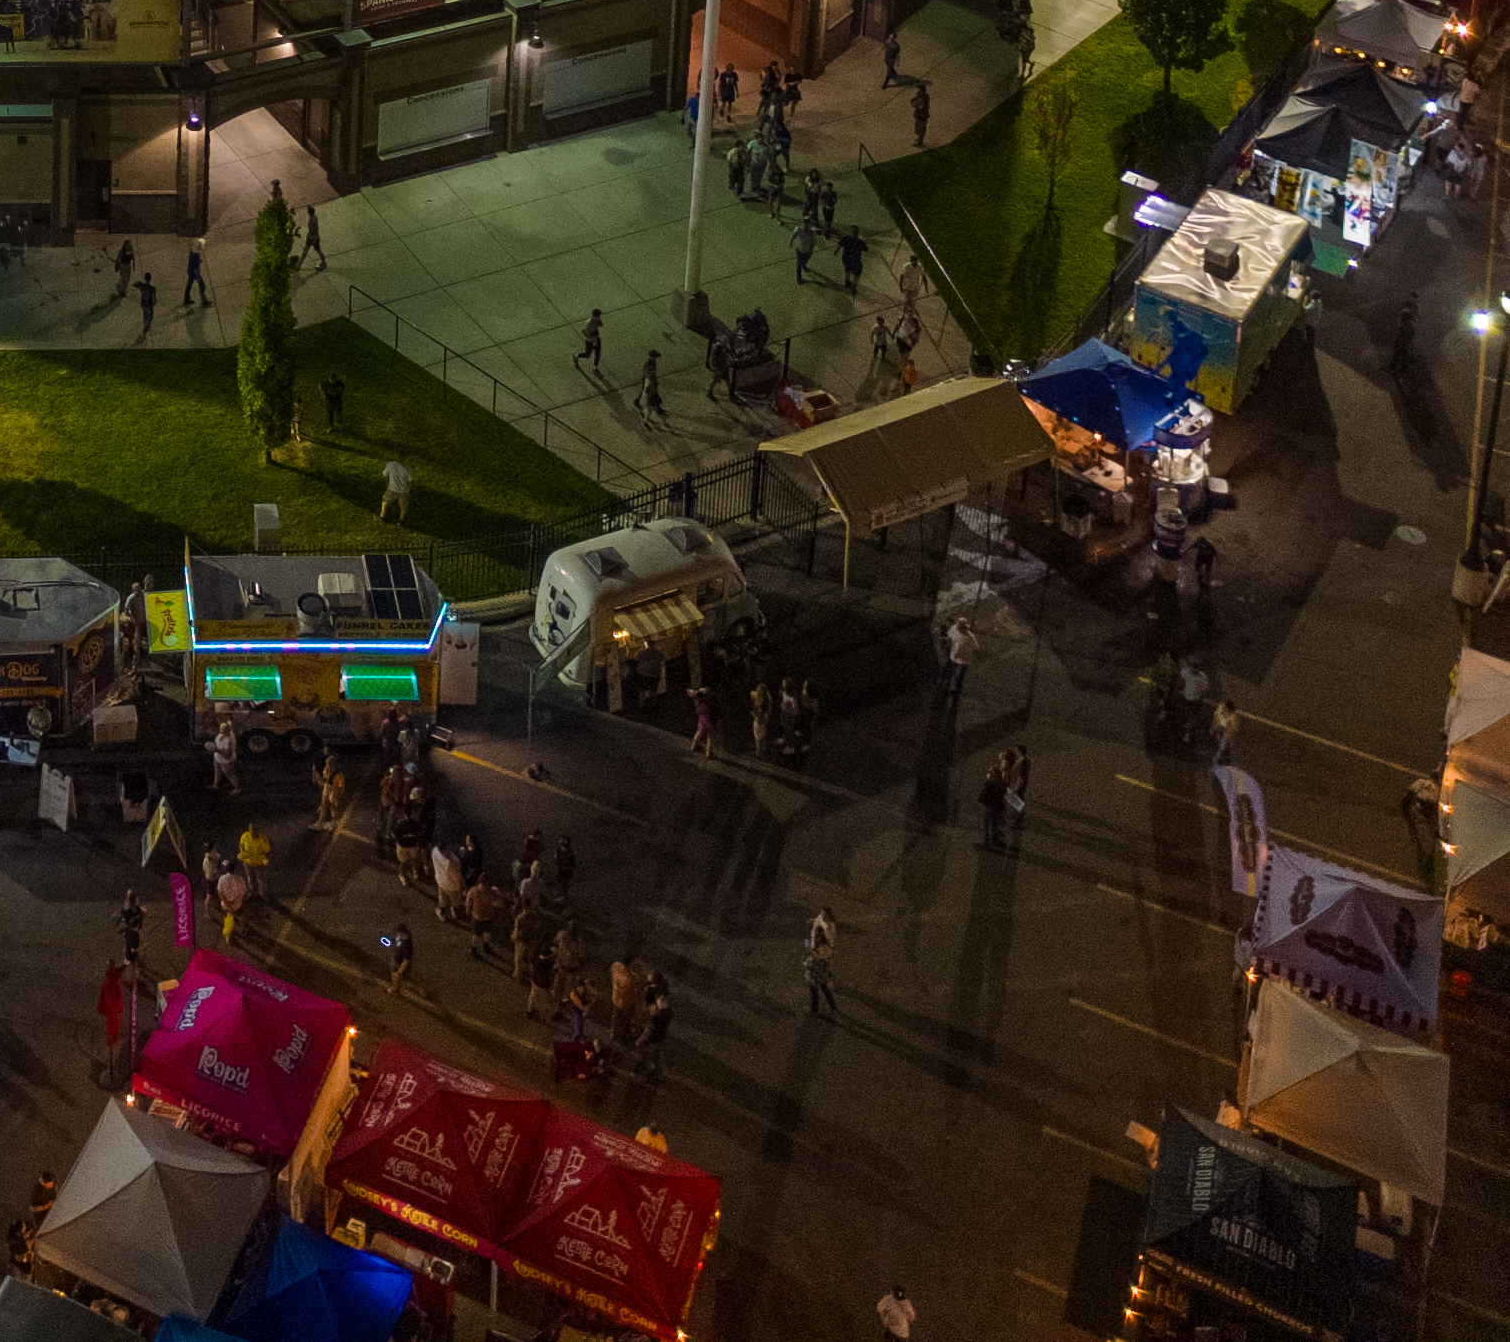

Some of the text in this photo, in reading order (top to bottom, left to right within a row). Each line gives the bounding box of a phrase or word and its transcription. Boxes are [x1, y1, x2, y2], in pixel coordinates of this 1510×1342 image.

[571, 47, 627, 65] Concessions
[406, 85, 464, 105] Concessions
[337, 622, 430, 631] FUNNEL CAKES
[7, 661, 39, 680] DOG
[181, 1099, 240, 1131] LICORICE
[421, 1171, 453, 1195] CORN
[1192, 1146, 1216, 1211] SAN DIABLO
[442, 1223, 478, 1249] CORN
[1210, 1217, 1295, 1269] SAN DIABLO
[595, 1250, 628, 1276] CORN
[1176, 1266, 1212, 1286] FRESH
[1215, 1282, 1253, 1306] FILLED
